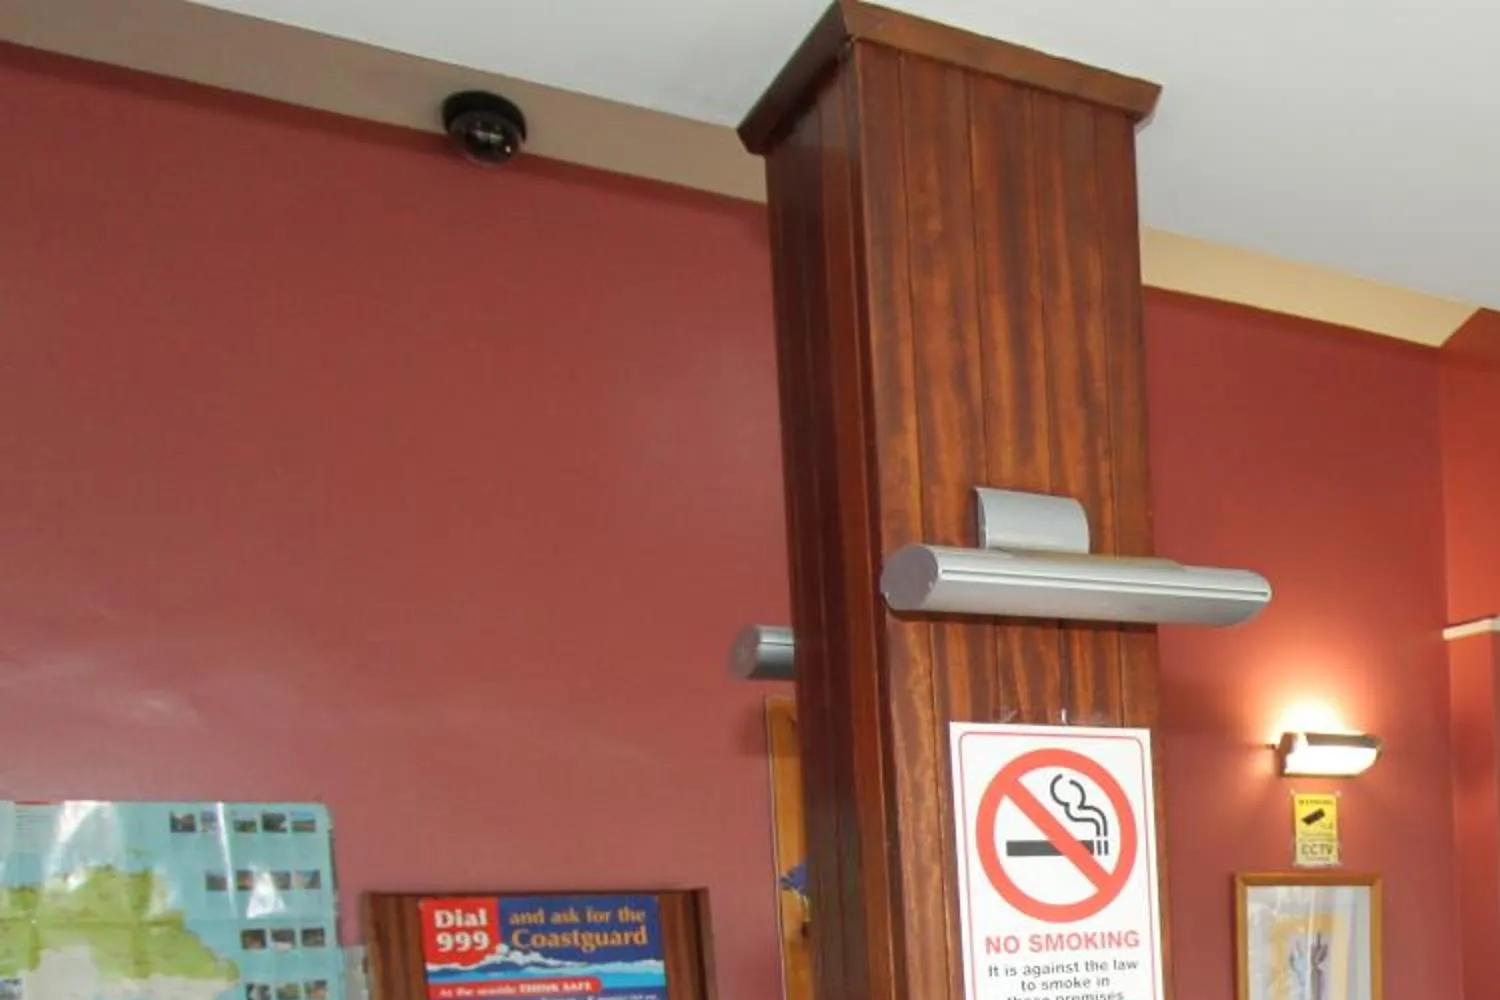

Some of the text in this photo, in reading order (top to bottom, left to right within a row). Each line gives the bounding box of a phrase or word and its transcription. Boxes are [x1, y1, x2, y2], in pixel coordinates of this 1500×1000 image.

[1301, 843, 1334, 855] CCTV
[433, 904, 646, 929] Dial and ask for the
[435, 925, 649, 952] 999 Coastguard
[984, 930, 1141, 955] NO SMOKING
[988, 957, 1139, 977] It is against the law
[1020, 975, 1111, 991] to smoke in
